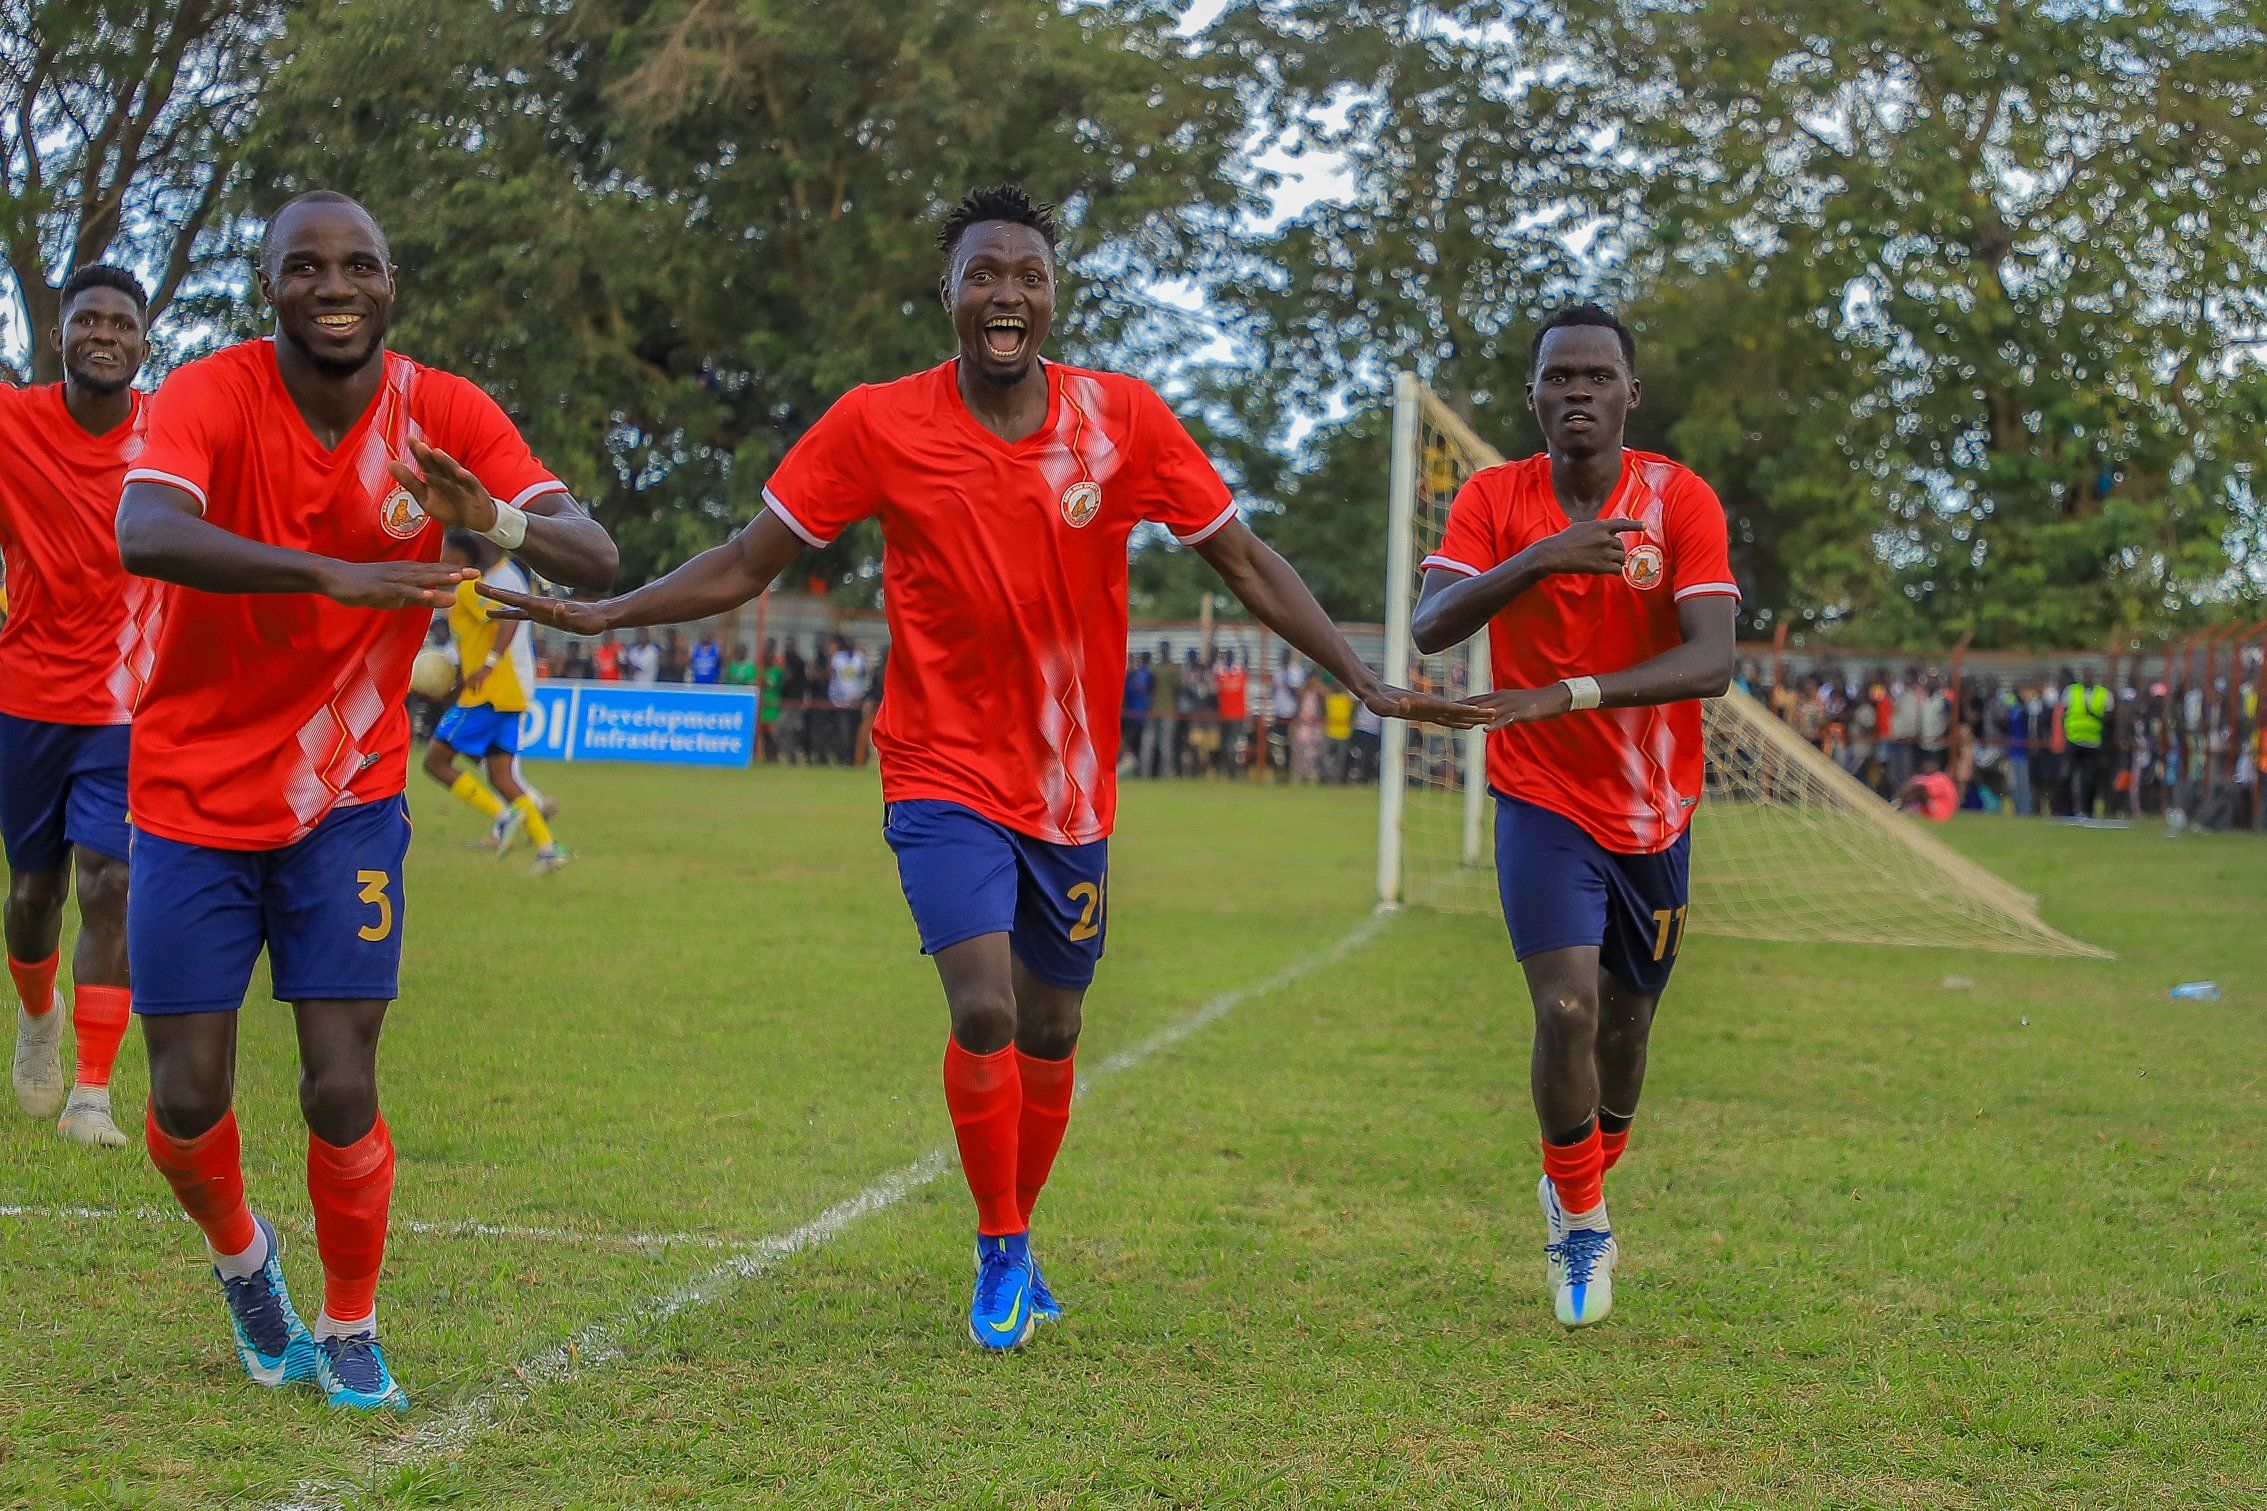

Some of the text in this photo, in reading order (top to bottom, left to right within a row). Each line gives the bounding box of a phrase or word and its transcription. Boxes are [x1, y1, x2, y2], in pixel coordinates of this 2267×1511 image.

[588, 703, 744, 731] Development
[585, 728, 743, 753] Infrastructure
[357, 870, 392, 942] 3
